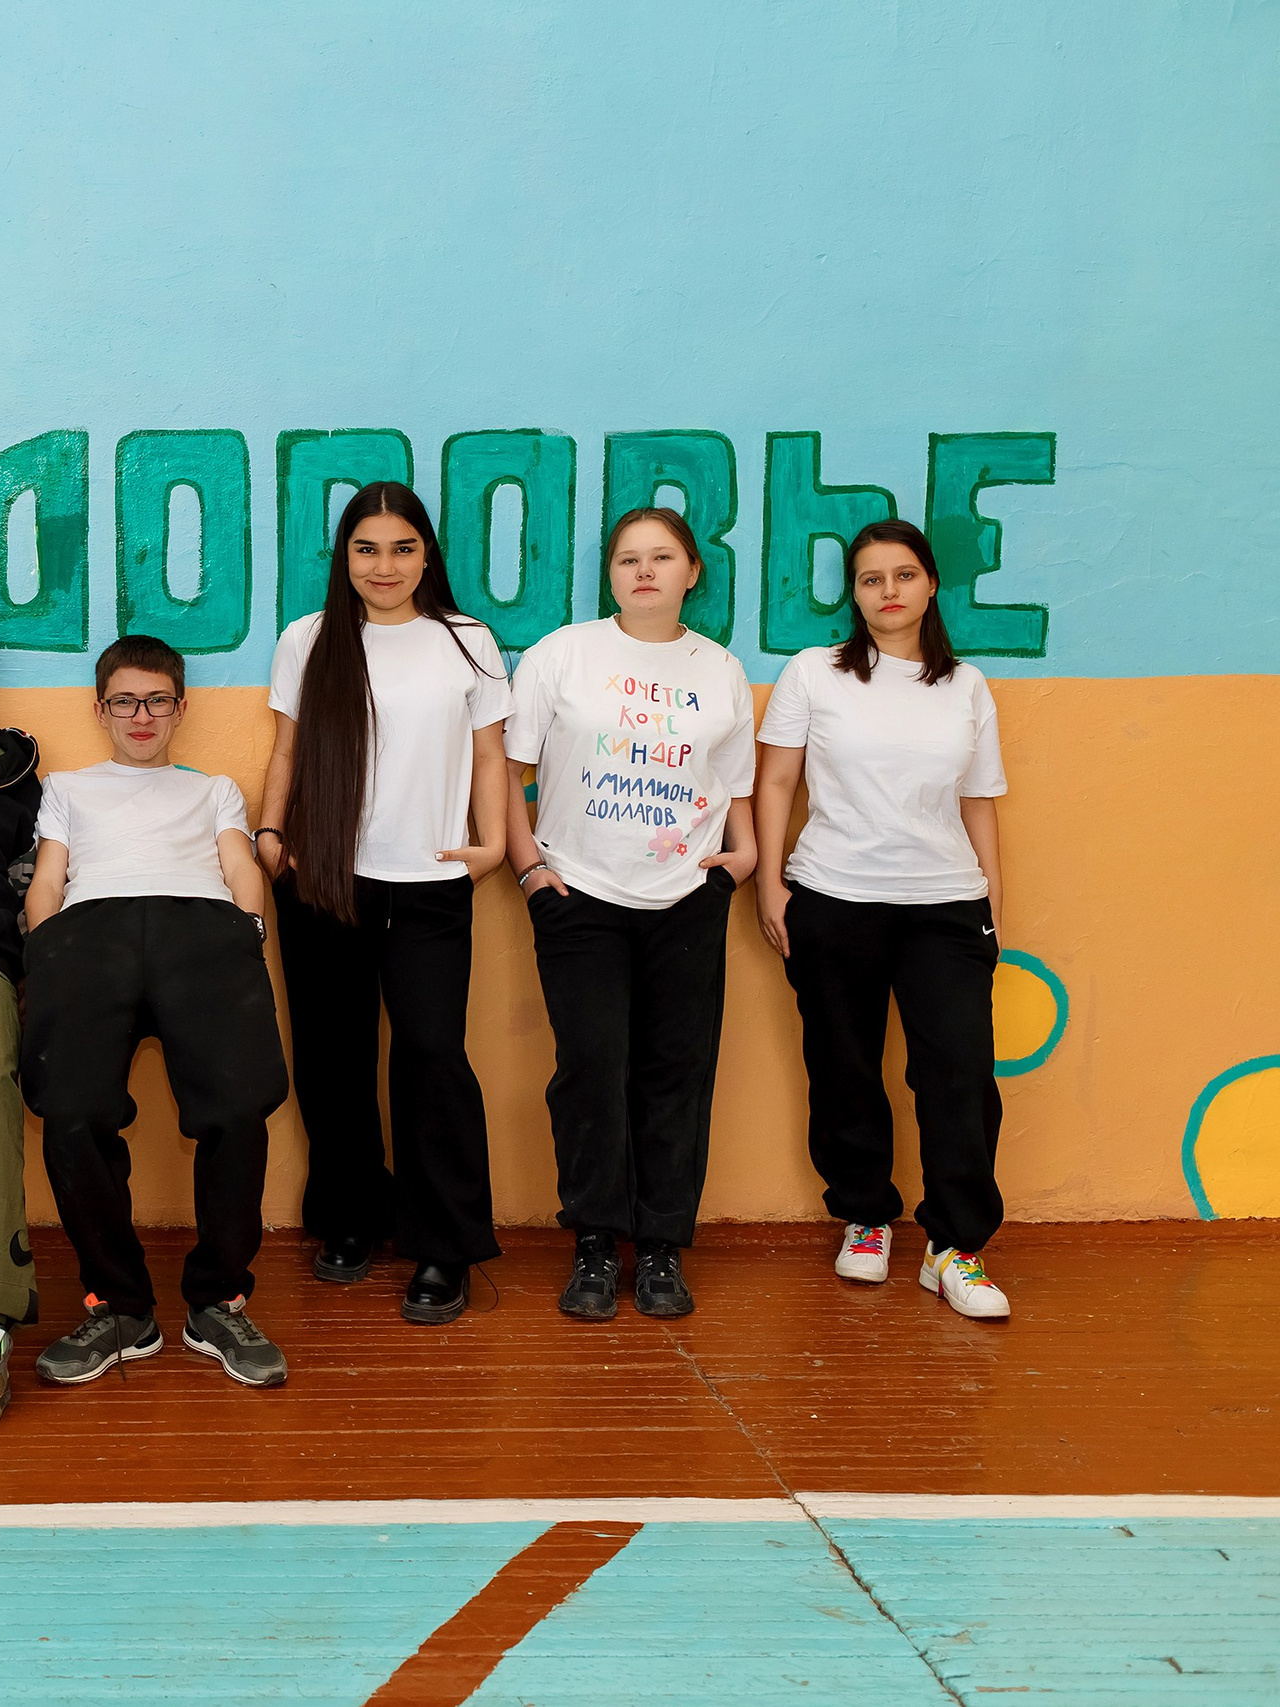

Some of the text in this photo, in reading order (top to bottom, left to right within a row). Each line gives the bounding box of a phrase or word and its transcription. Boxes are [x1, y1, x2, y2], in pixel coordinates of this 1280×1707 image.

[604, 674, 700, 711] ХОЧЕТСЯ
[596, 732, 692, 768] КИНДЕР
[581, 766, 693, 803] И МИЛЛИОН
[585, 798, 677, 828] ДОЛЛАРОВ
